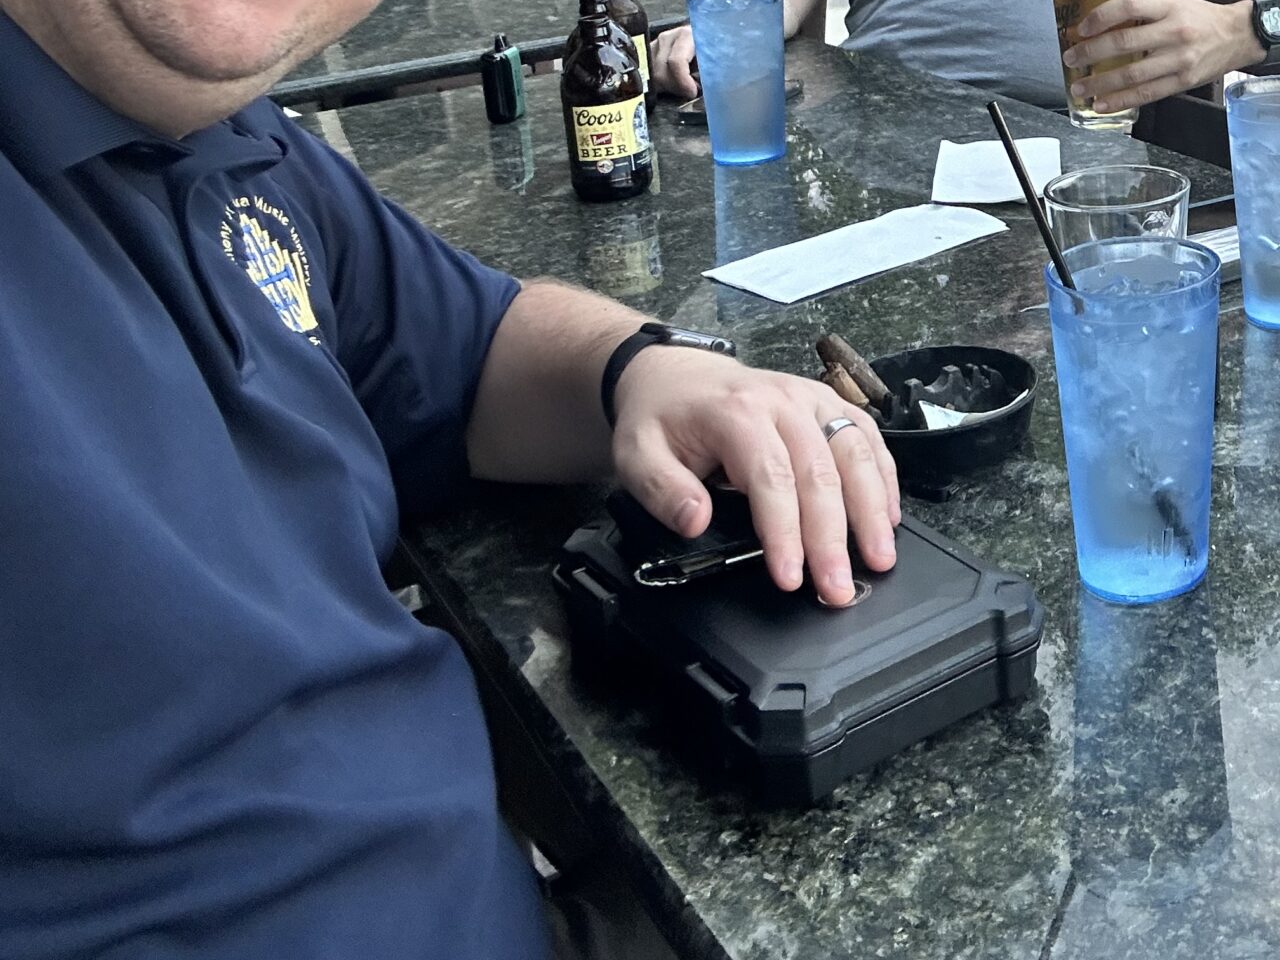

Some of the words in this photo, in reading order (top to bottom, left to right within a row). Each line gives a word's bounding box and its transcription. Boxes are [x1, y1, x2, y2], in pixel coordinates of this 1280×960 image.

[575, 109, 623, 127] Coors
[581, 144, 629, 158] BEER
[254, 195, 289, 226] Music
